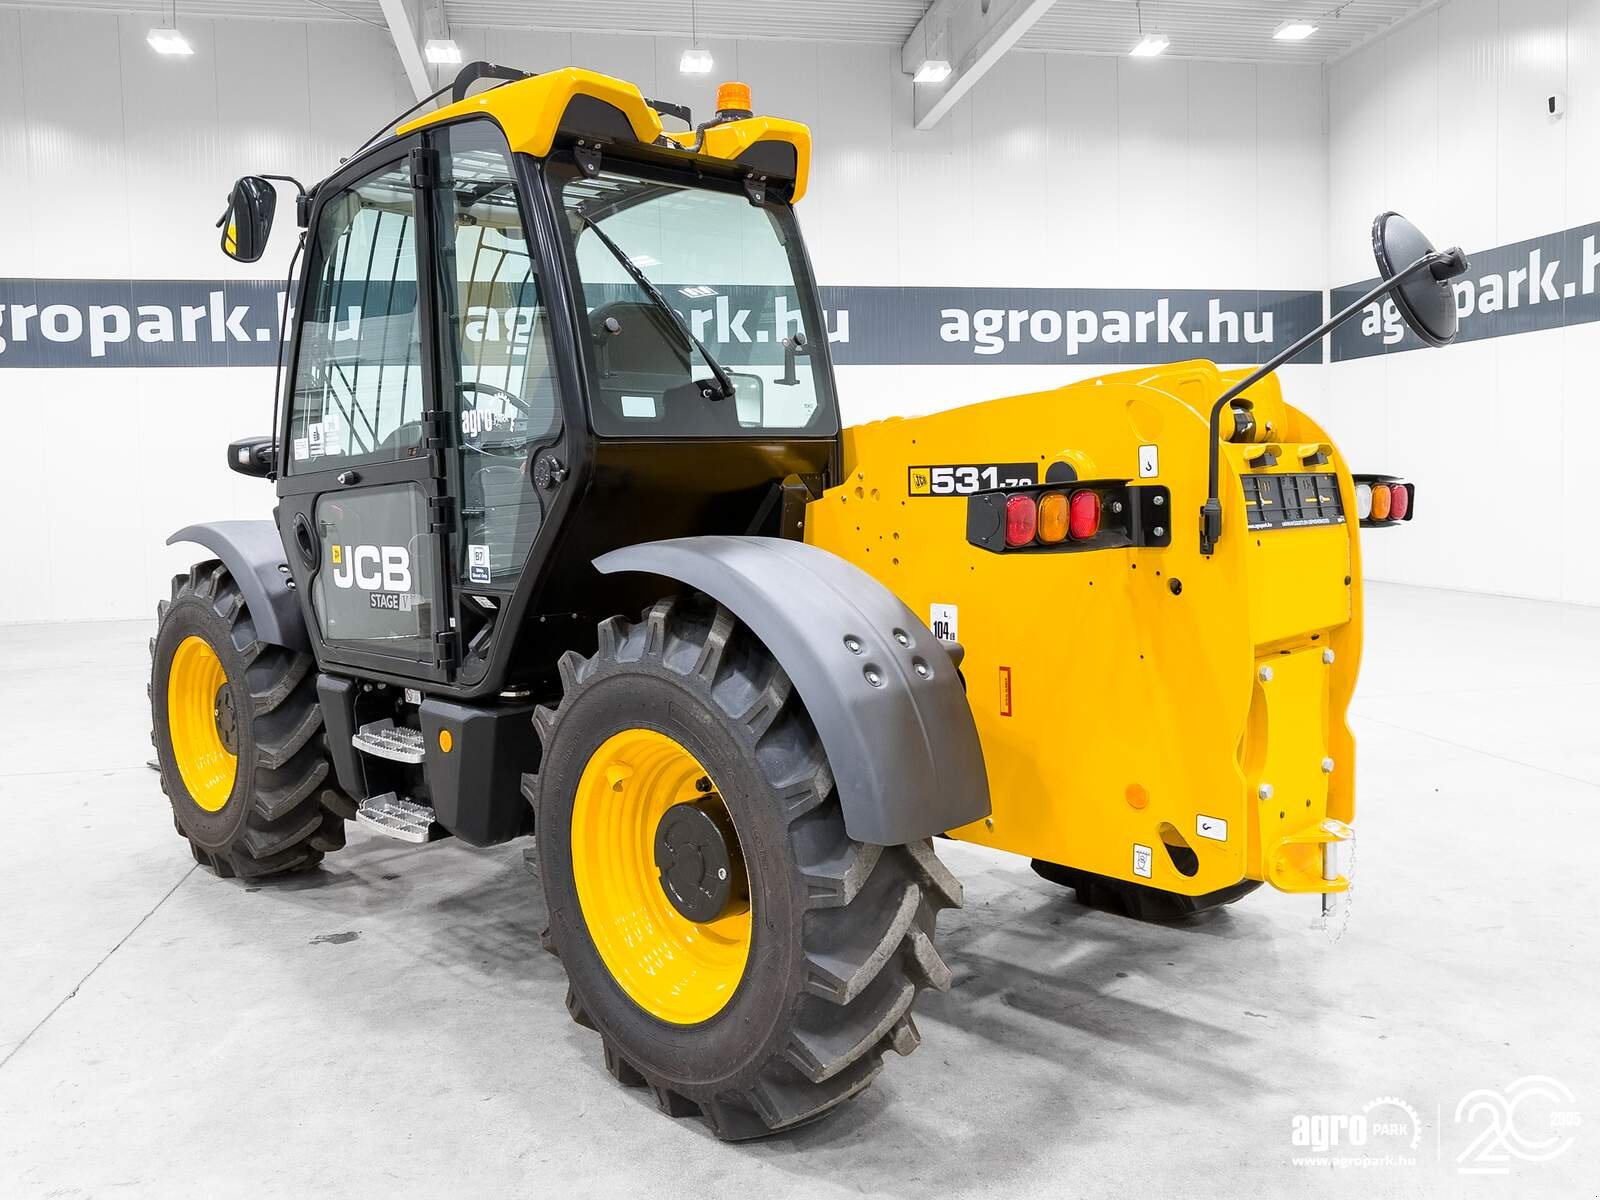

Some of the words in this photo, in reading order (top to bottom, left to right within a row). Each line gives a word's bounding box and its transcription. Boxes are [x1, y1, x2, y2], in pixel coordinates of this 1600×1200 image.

[1361, 235, 1600, 345] agpark.h
[0, 291, 363, 357] ropark.u
[940, 299, 1273, 355] agropark.hu
[333, 545, 412, 592] JCB
[371, 594, 399, 609] STAGE
[933, 621, 949, 640] 104
